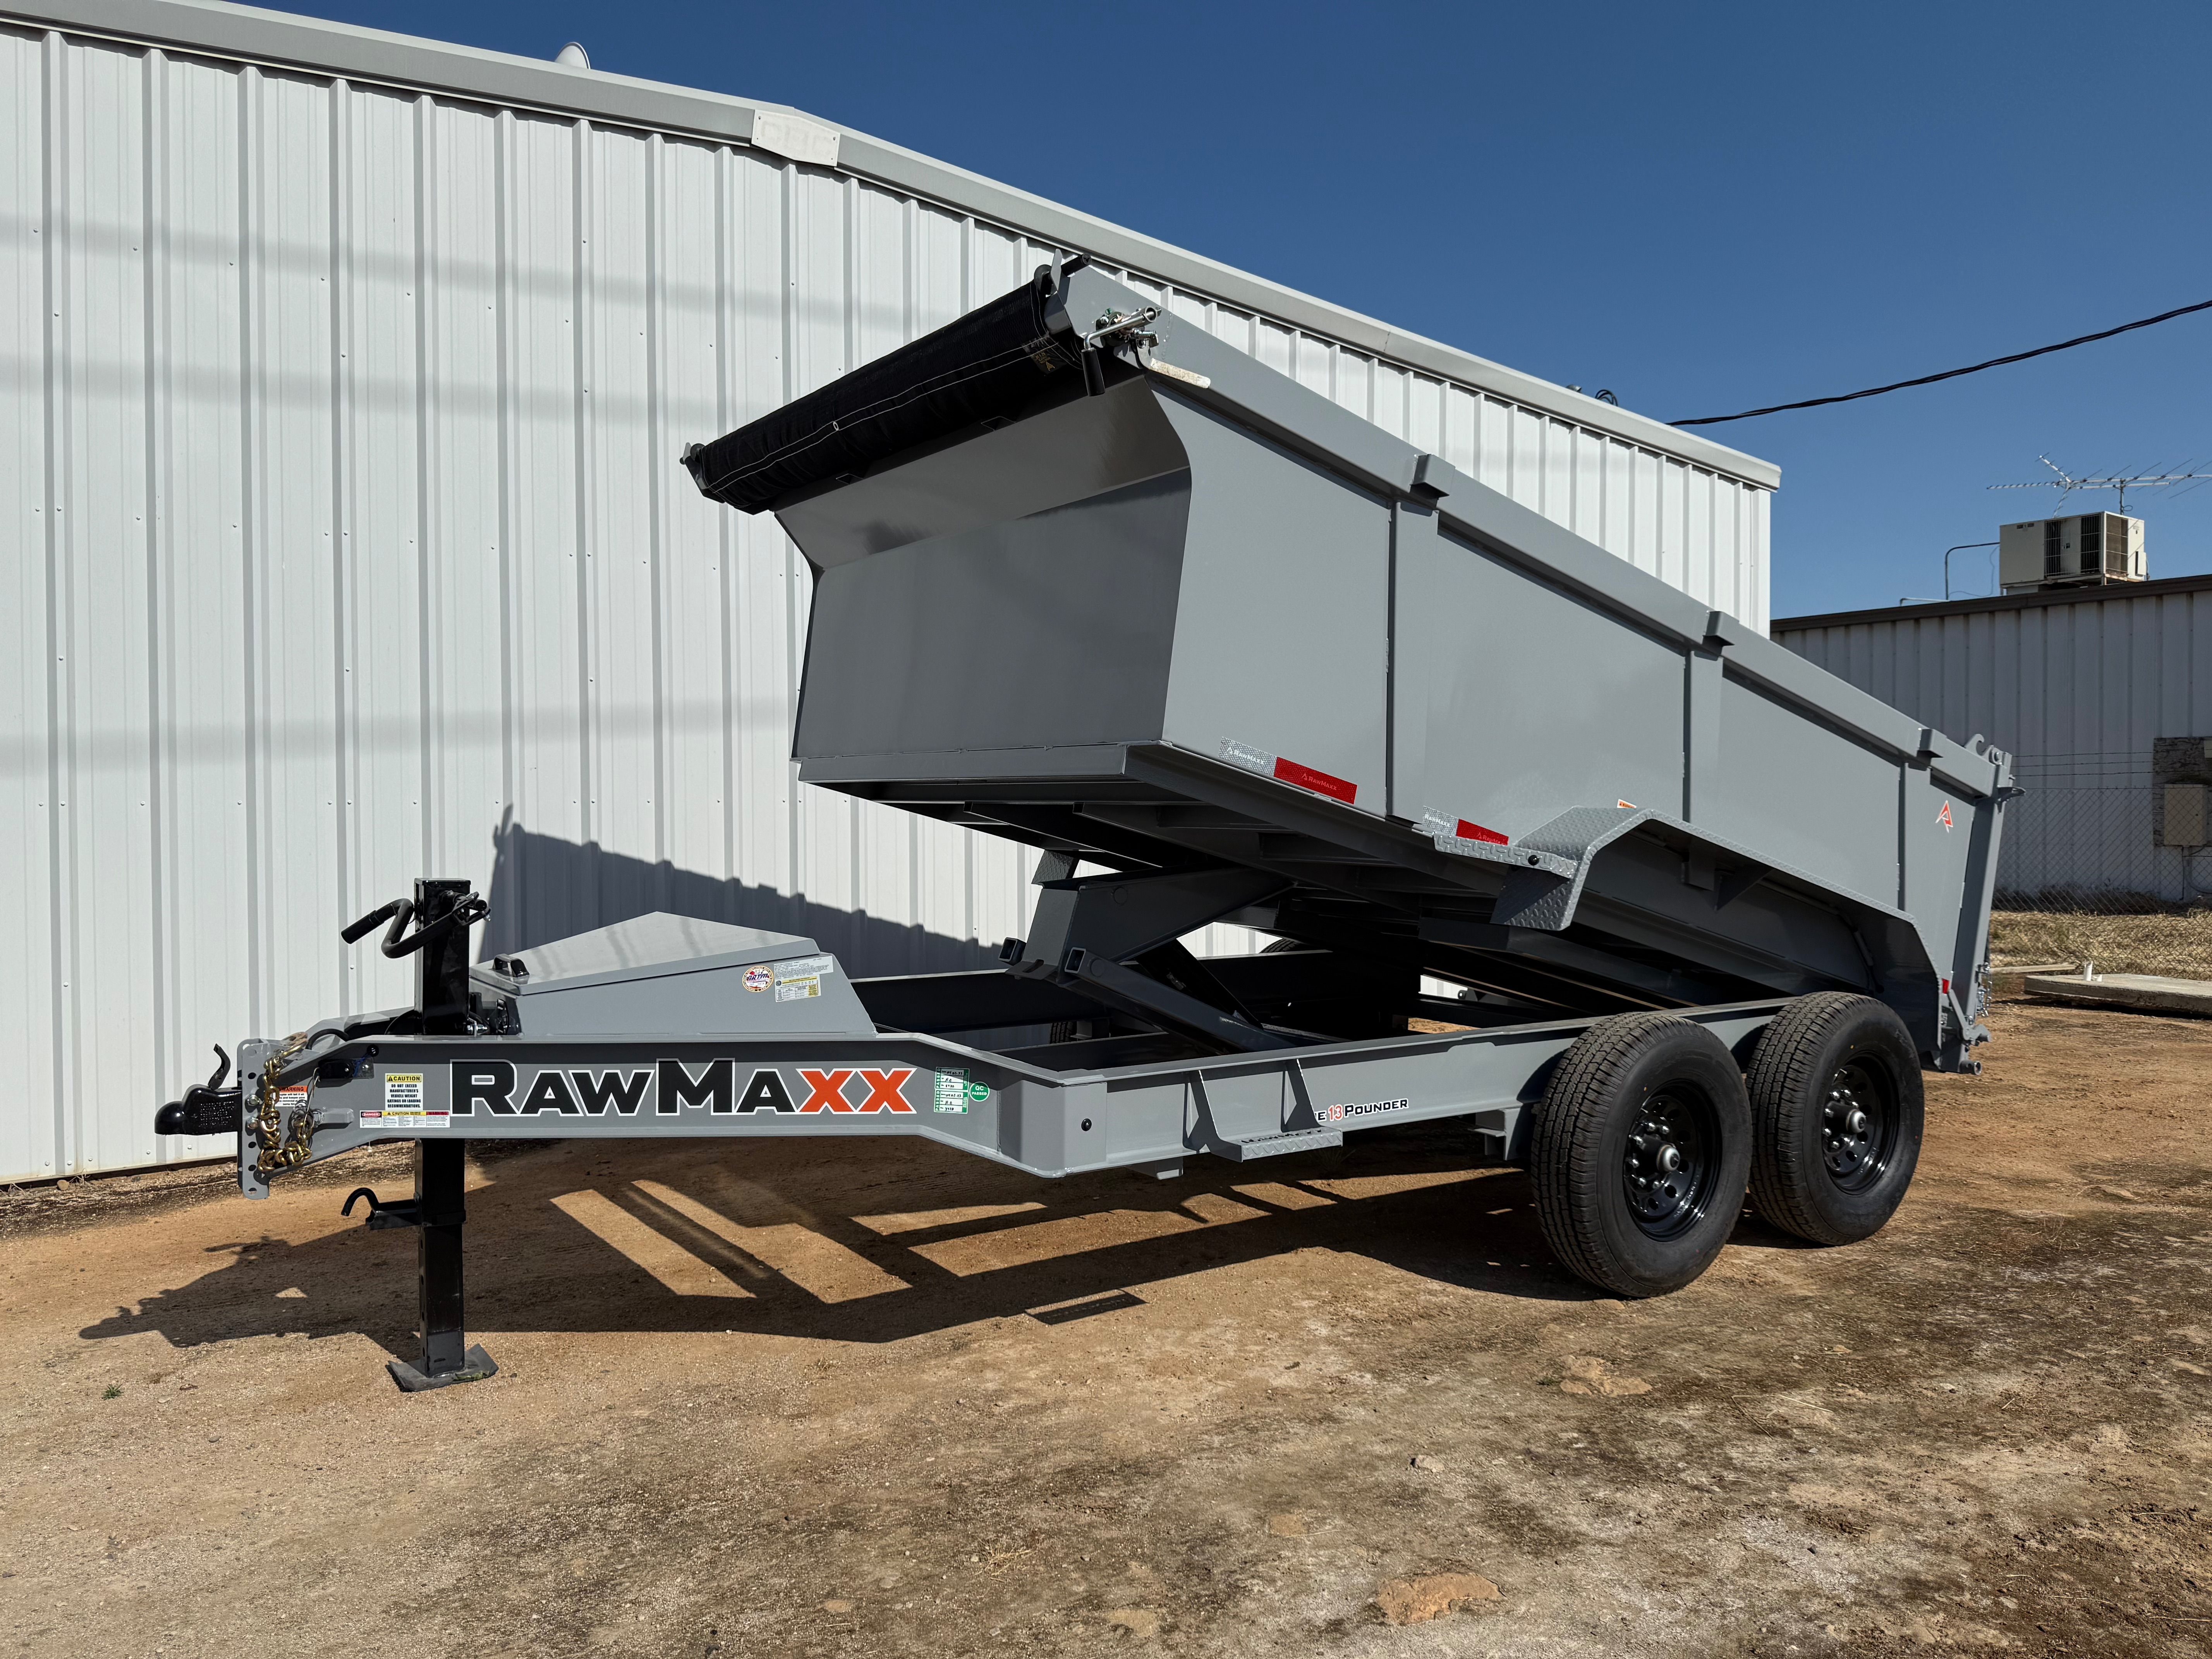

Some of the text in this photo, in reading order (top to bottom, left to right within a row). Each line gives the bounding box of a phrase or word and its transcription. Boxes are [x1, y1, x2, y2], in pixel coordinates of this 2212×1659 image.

[1308, 776, 1337, 790] RAWMAXX
[450, 1058, 917, 1117] RAWMAXX
[1329, 1105, 1342, 1120] 13
[1345, 1099, 1407, 1116] POUNDER
